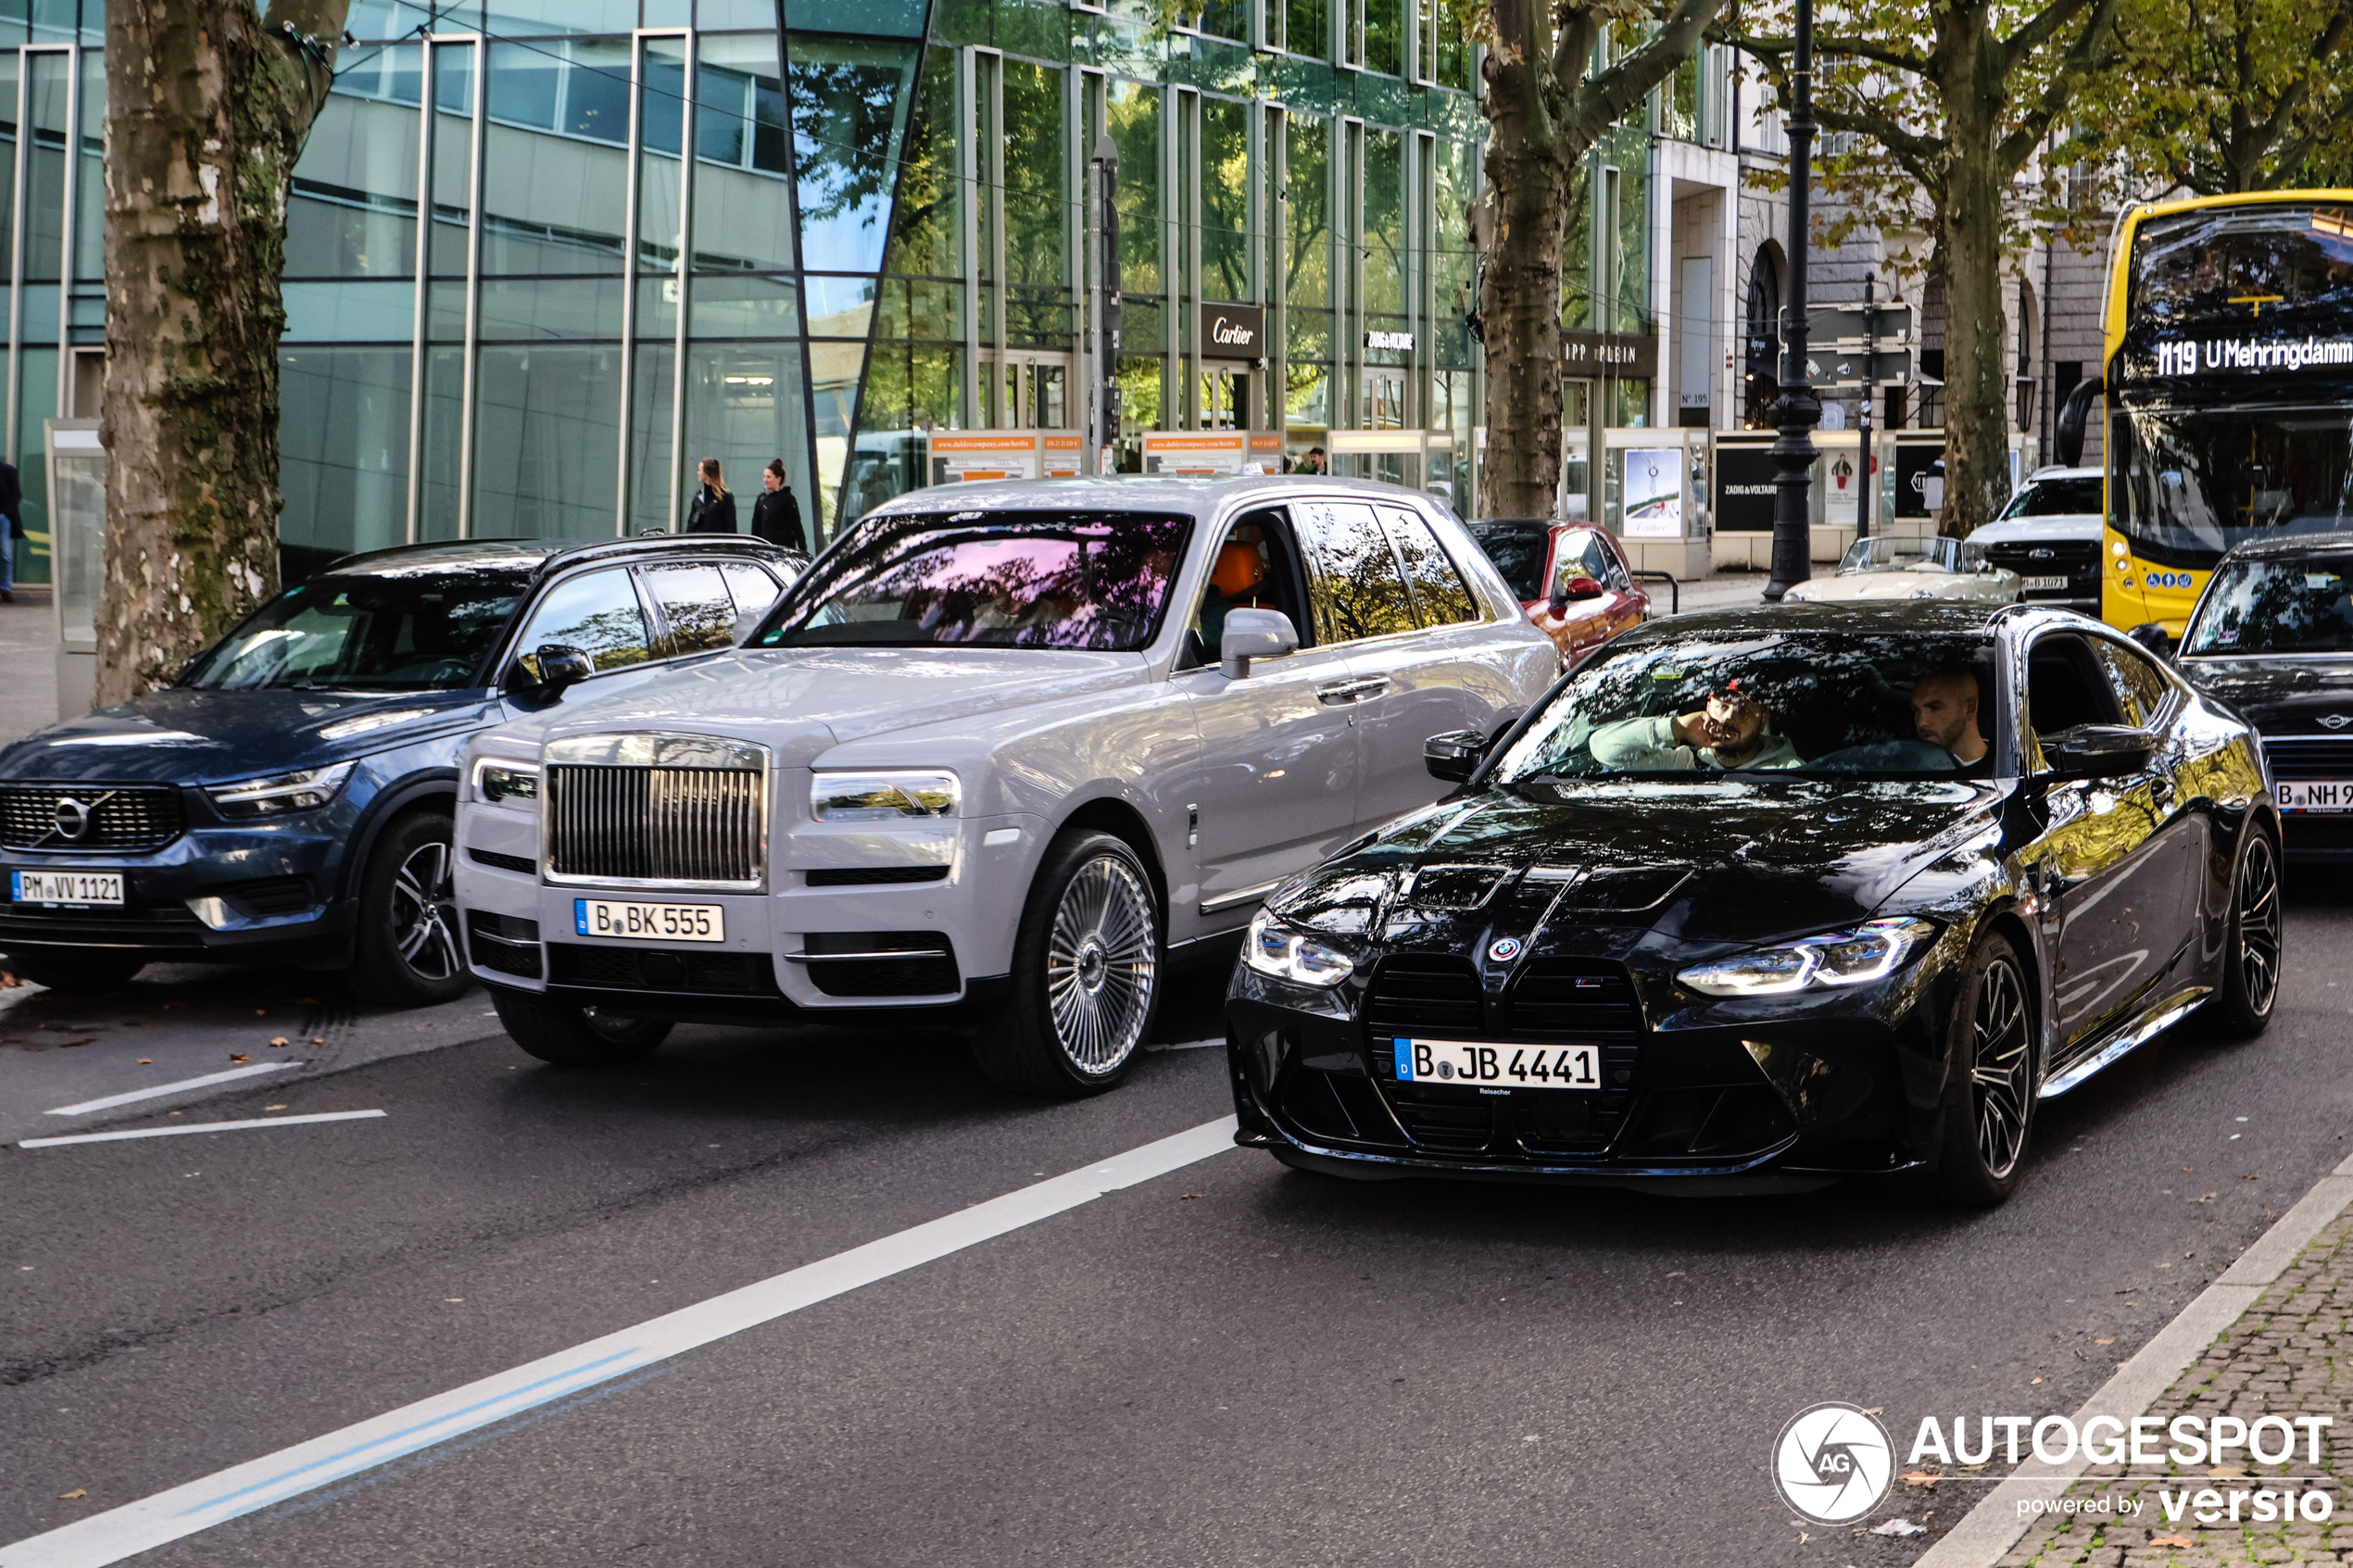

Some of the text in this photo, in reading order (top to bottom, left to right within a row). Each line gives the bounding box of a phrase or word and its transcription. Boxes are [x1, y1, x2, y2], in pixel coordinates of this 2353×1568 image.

[1213, 316, 1253, 345] Cartier
[1565, 343, 1636, 364] IPP PLEIN
[2158, 334, 2353, 376] M19 U Mehringdamm
[1694, 394, 1707, 404] 195
[937, 441, 1029, 449] www.dahlercompany.com/berlin
[1151, 441, 1237, 449] www.dahlercompany.com/berlin
[1637, 522, 1668, 533] Cartier
[2043, 578, 2064, 588] 1071
[2279, 785, 2293, 805] B
[2308, 784, 2337, 805] NH
[23, 876, 120, 900] PM VV 1121
[597, 905, 711, 935] B BK 555
[1401, 1063, 1409, 1074] D
[1414, 1044, 1596, 1085] B JB 4441
[1479, 1087, 1512, 1097] Reisacher
